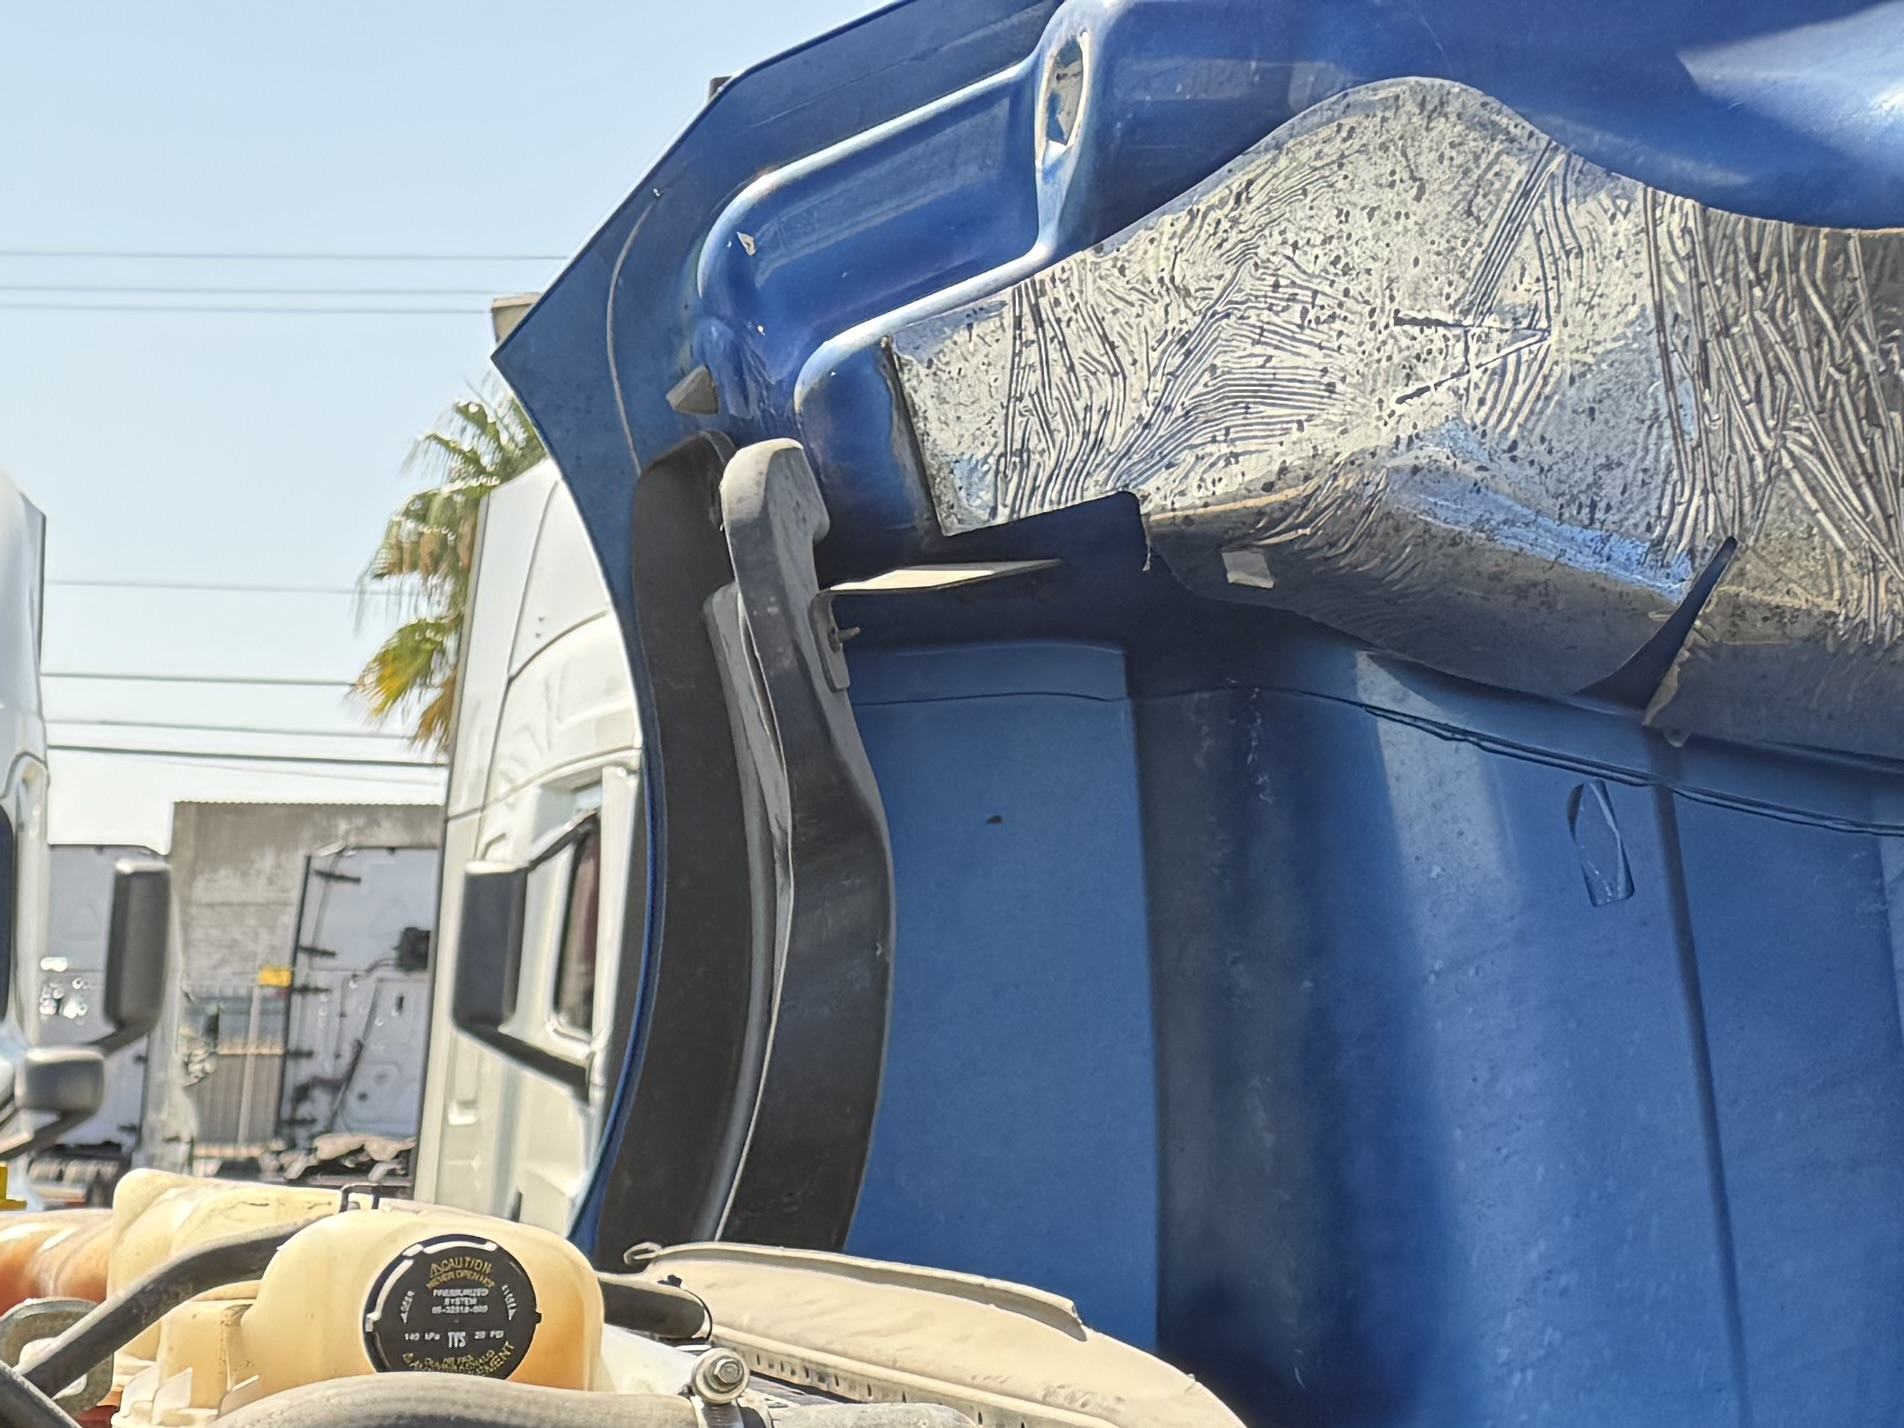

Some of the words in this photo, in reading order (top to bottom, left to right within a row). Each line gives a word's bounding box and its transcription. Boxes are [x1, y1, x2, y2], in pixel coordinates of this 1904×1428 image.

[441, 1256, 492, 1274] CAUTION
[456, 1269, 479, 1281] OPEN
[444, 1297, 477, 1306] SYSTEM
